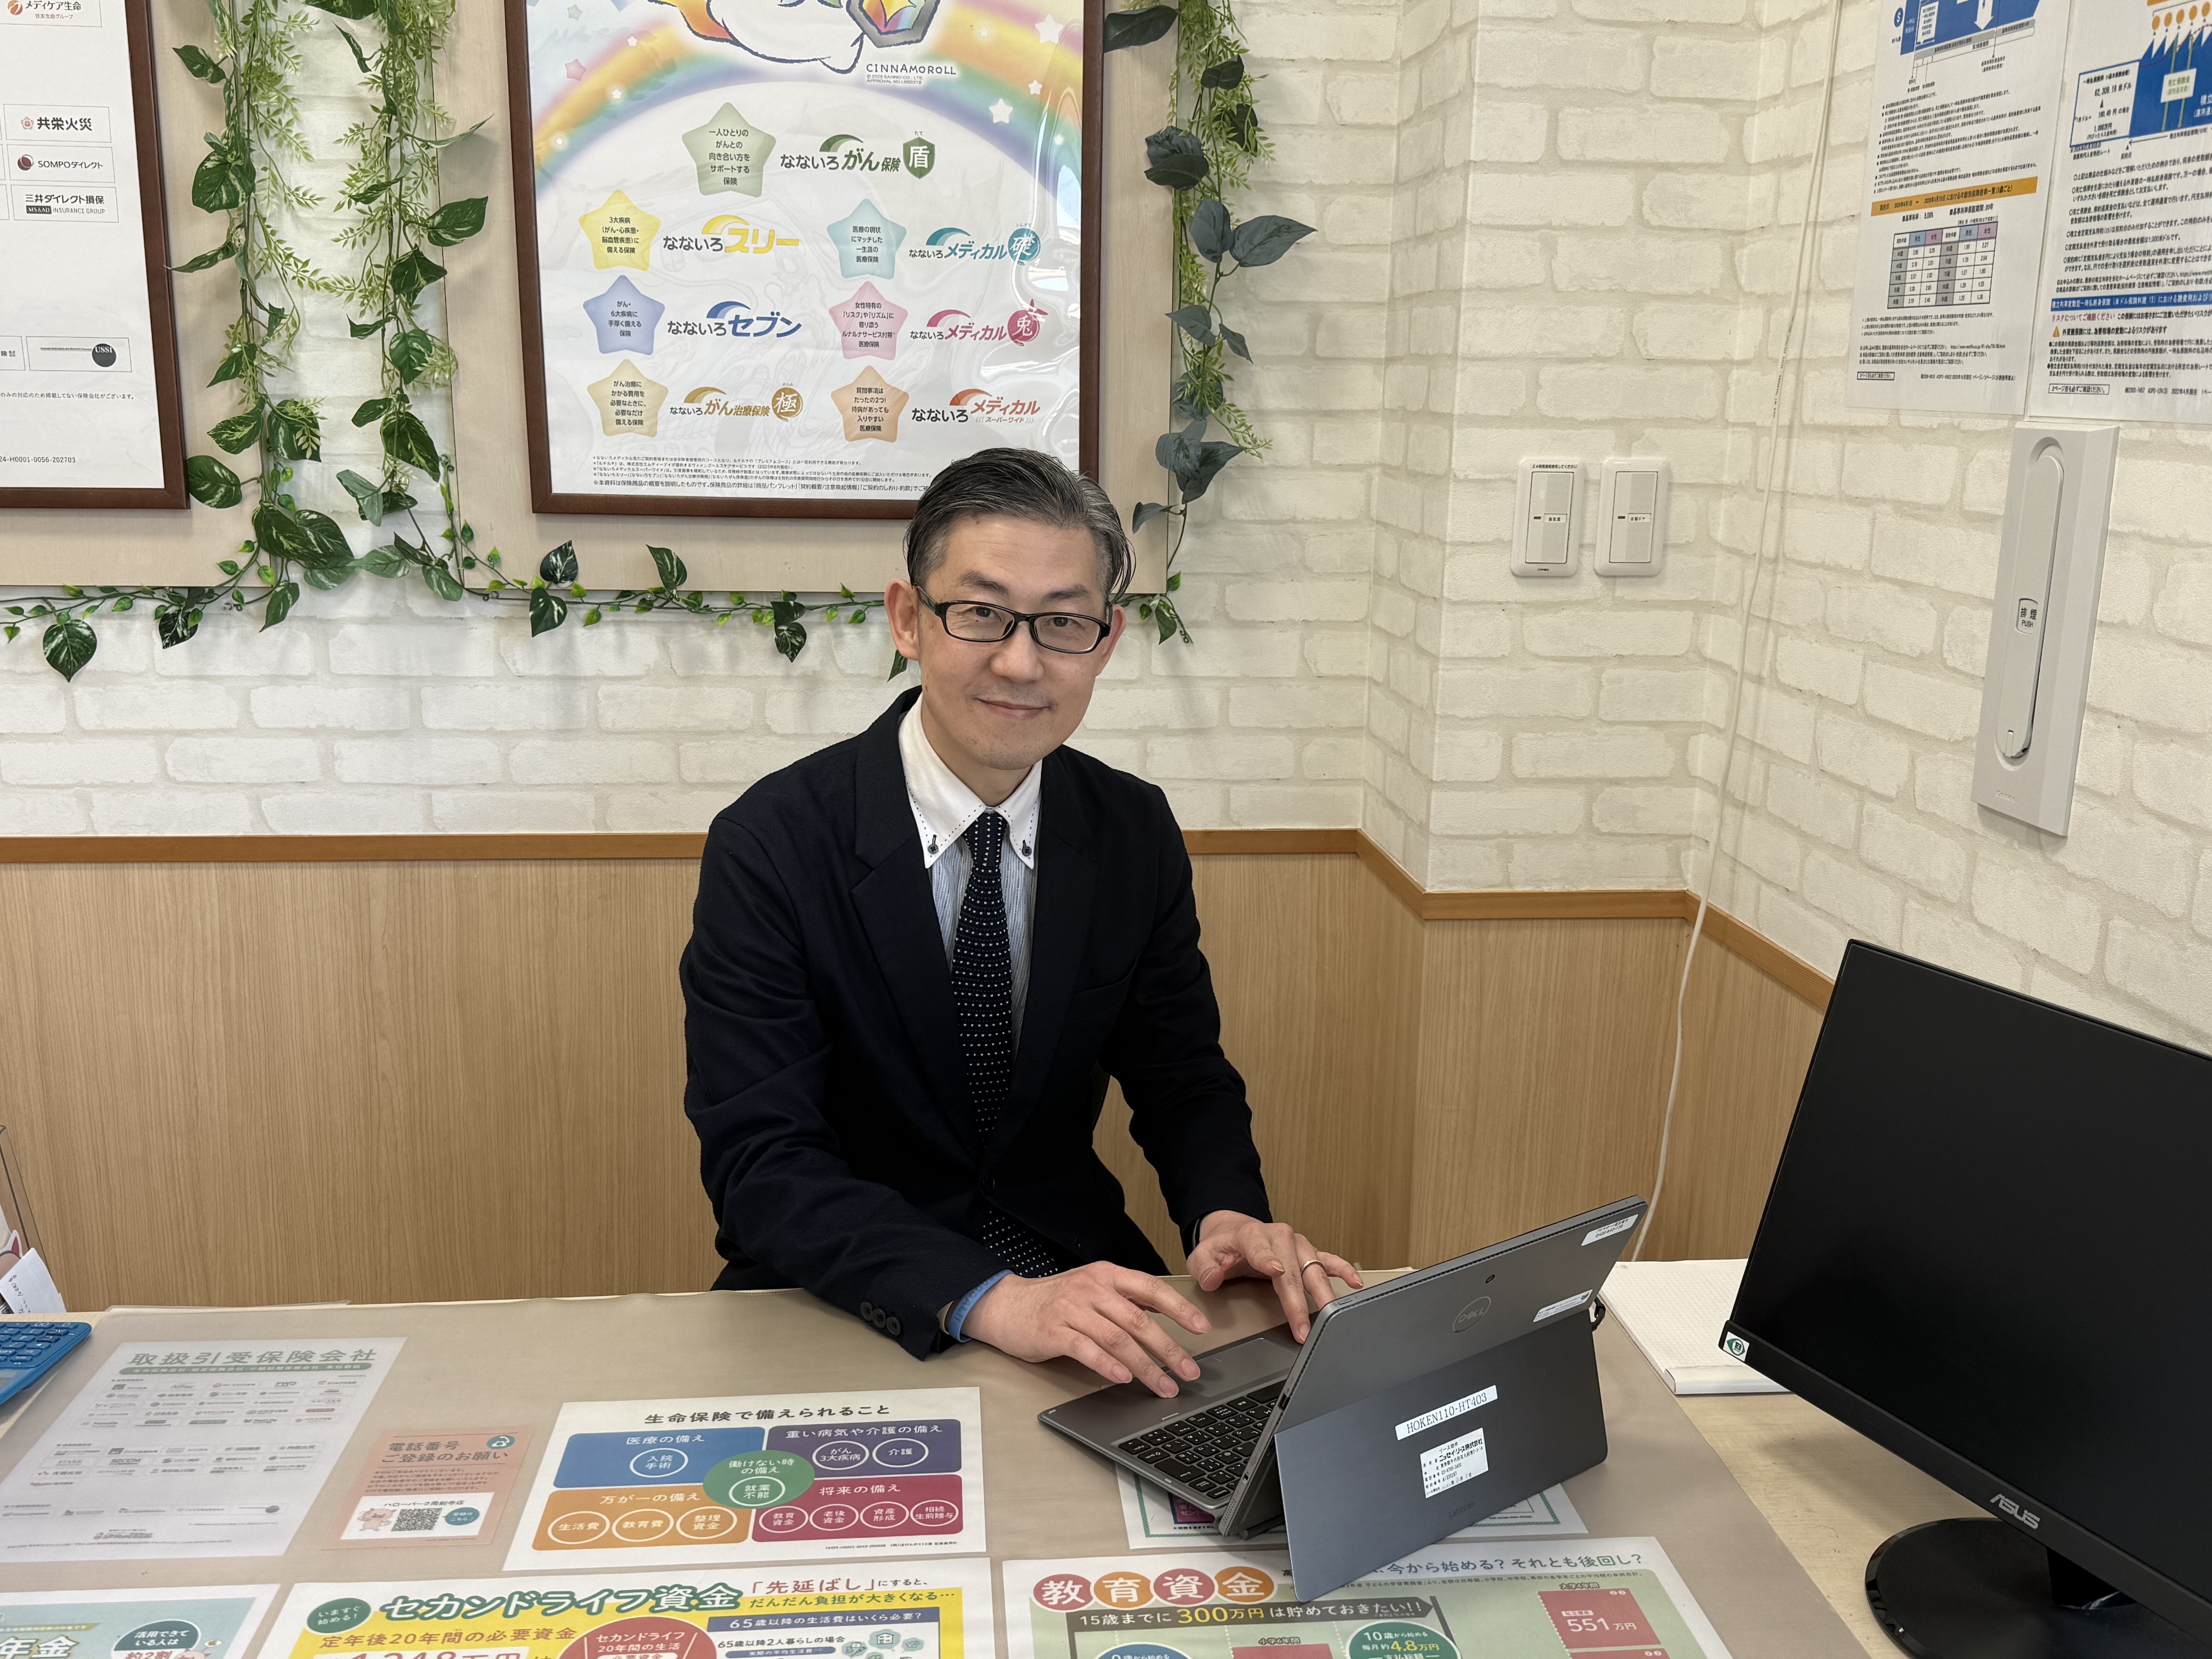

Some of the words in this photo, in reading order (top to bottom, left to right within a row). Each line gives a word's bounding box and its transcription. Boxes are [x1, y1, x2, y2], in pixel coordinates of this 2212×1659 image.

[25, 1, 81, 11] メディケア生命
[866, 64, 956, 74] CINNAMOROLL
[37, 117, 92, 131] 共栄火災
[709, 153, 750, 161] 向き合い方を
[909, 146, 929, 168] 盾
[38, 160, 103, 169] SOMPOダイレクト
[710, 165, 750, 173] サポートする
[724, 177, 737, 185] 保険
[25, 194, 104, 204] 三井ダイレクト損保
[663, 228, 799, 253] なないろスリー
[910, 240, 1007, 259] なないろメディカル
[668, 311, 802, 338] なないろセブン
[910, 323, 1006, 340] なないろメディカル
[2021, 620, 2033, 628] PUSH
[128, 1349, 376, 1365] 取扱引受保険会社
[644, 1405, 890, 1424] 生命保険で備えられること
[1407, 1393, 1487, 1434] HOKEN110-HT403
[786, 1425, 943, 1439] 重い病気や介護の備え
[389, 1441, 460, 1451] 電話番号
[626, 1435, 705, 1445] 医療の備え
[382, 1451, 508, 1463] ご登録のお願い
[729, 1458, 794, 1468] 働けない時
[740, 1466, 780, 1475] の備え
[819, 1484, 901, 1496] 将来の備え
[600, 1492, 701, 1504] 万が一の備え
[1449, 1500, 1475, 1518] Latitude
[1990, 1493, 2040, 1530] ASUS
[558, 1522, 600, 1531] 生活費
[622, 1520, 664, 1529] 教育費
[692, 1522, 720, 1530] 資金
[1511, 1554, 1642, 1568] それとも後回し?
[751, 1578, 876, 1594] 「先延ばし」
[878, 1578, 927, 1587] にすると、
[1041, 1572, 1265, 1605] 教育資金
[381, 1582, 744, 1621] セカンドライフ資金
[318, 1606, 361, 1618] いますぐ
[1080, 1613, 1172, 1625] 15歳までに
[1177, 1607, 1265, 1624] 300万円
[317, 1614, 358, 1625] 始める!
[730, 1613, 921, 1628] 65歳以降の生活費はいくら必要?
[1567, 1618, 1609, 1632] 551
[134, 1630, 189, 1638] 活用できて
[319, 1627, 577, 1648] 定年後20年間の必要資金
[596, 1632, 685, 1643] セカンドライフ
[1364, 1632, 1382, 1641] 10
[136, 1638, 180, 1647] いる人は
[598, 1642, 681, 1652] 20年間の生活
[718, 1636, 845, 1649] 65歳以降2人暮らしの場合
[1391, 1640, 1417, 1651] 4.8
